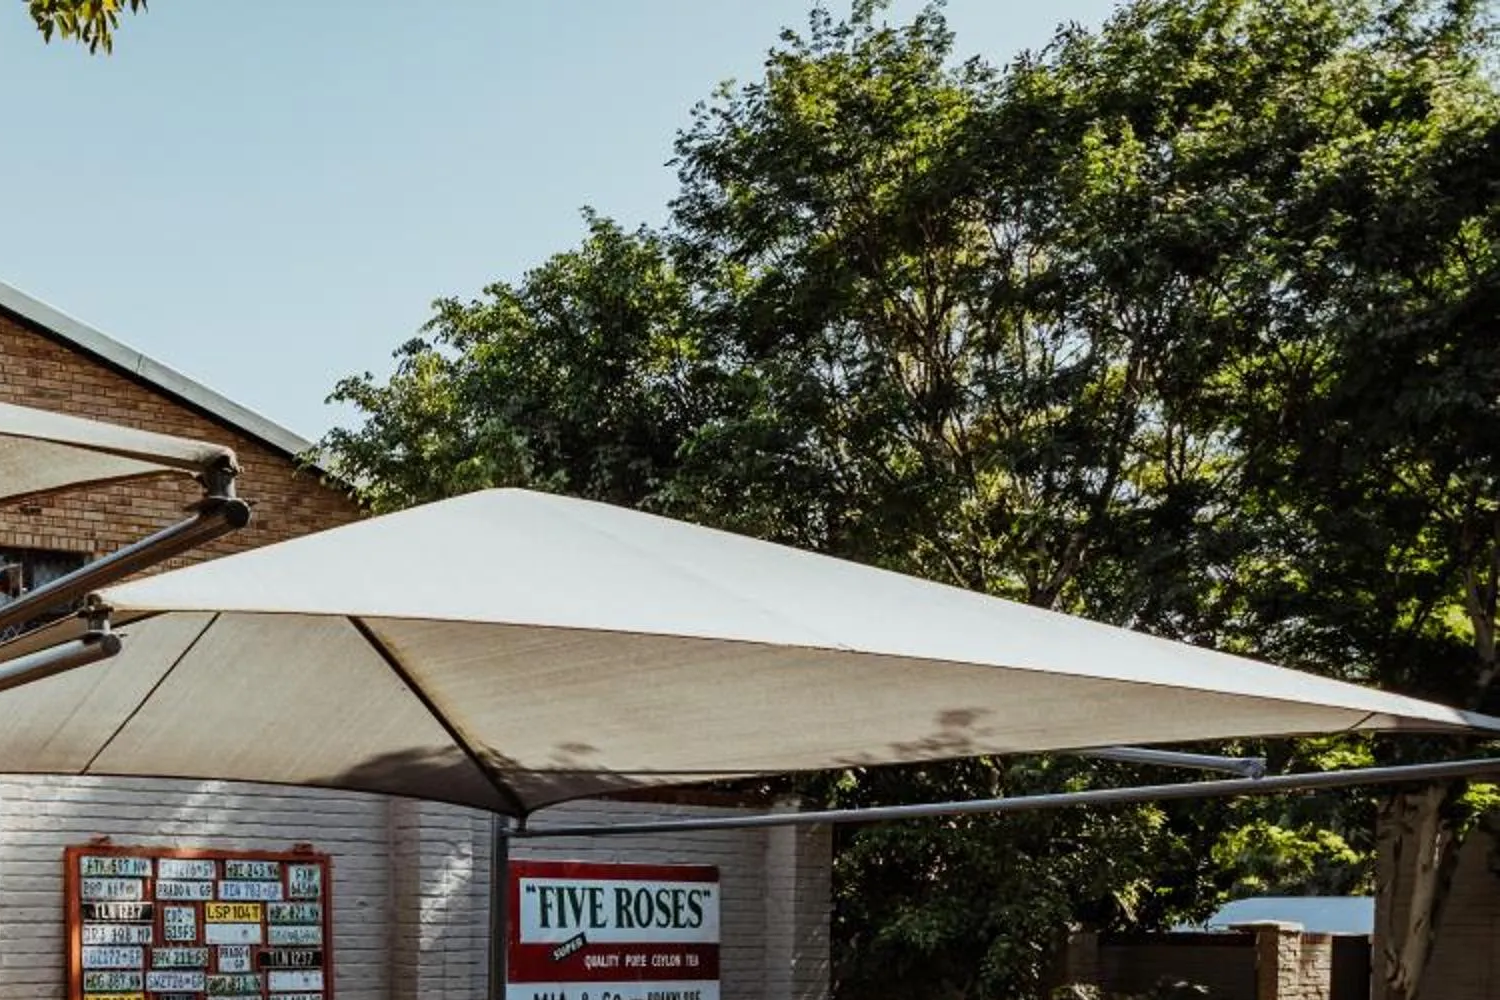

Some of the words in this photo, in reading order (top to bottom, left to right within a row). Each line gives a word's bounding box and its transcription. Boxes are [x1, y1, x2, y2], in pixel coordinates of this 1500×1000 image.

[553, 937, 584, 961] SUPER
[584, 954, 619, 970] QUALITY
[625, 954, 647, 967] PURE
[652, 954, 681, 967] CEYLON
[685, 954, 700, 967] TEA
